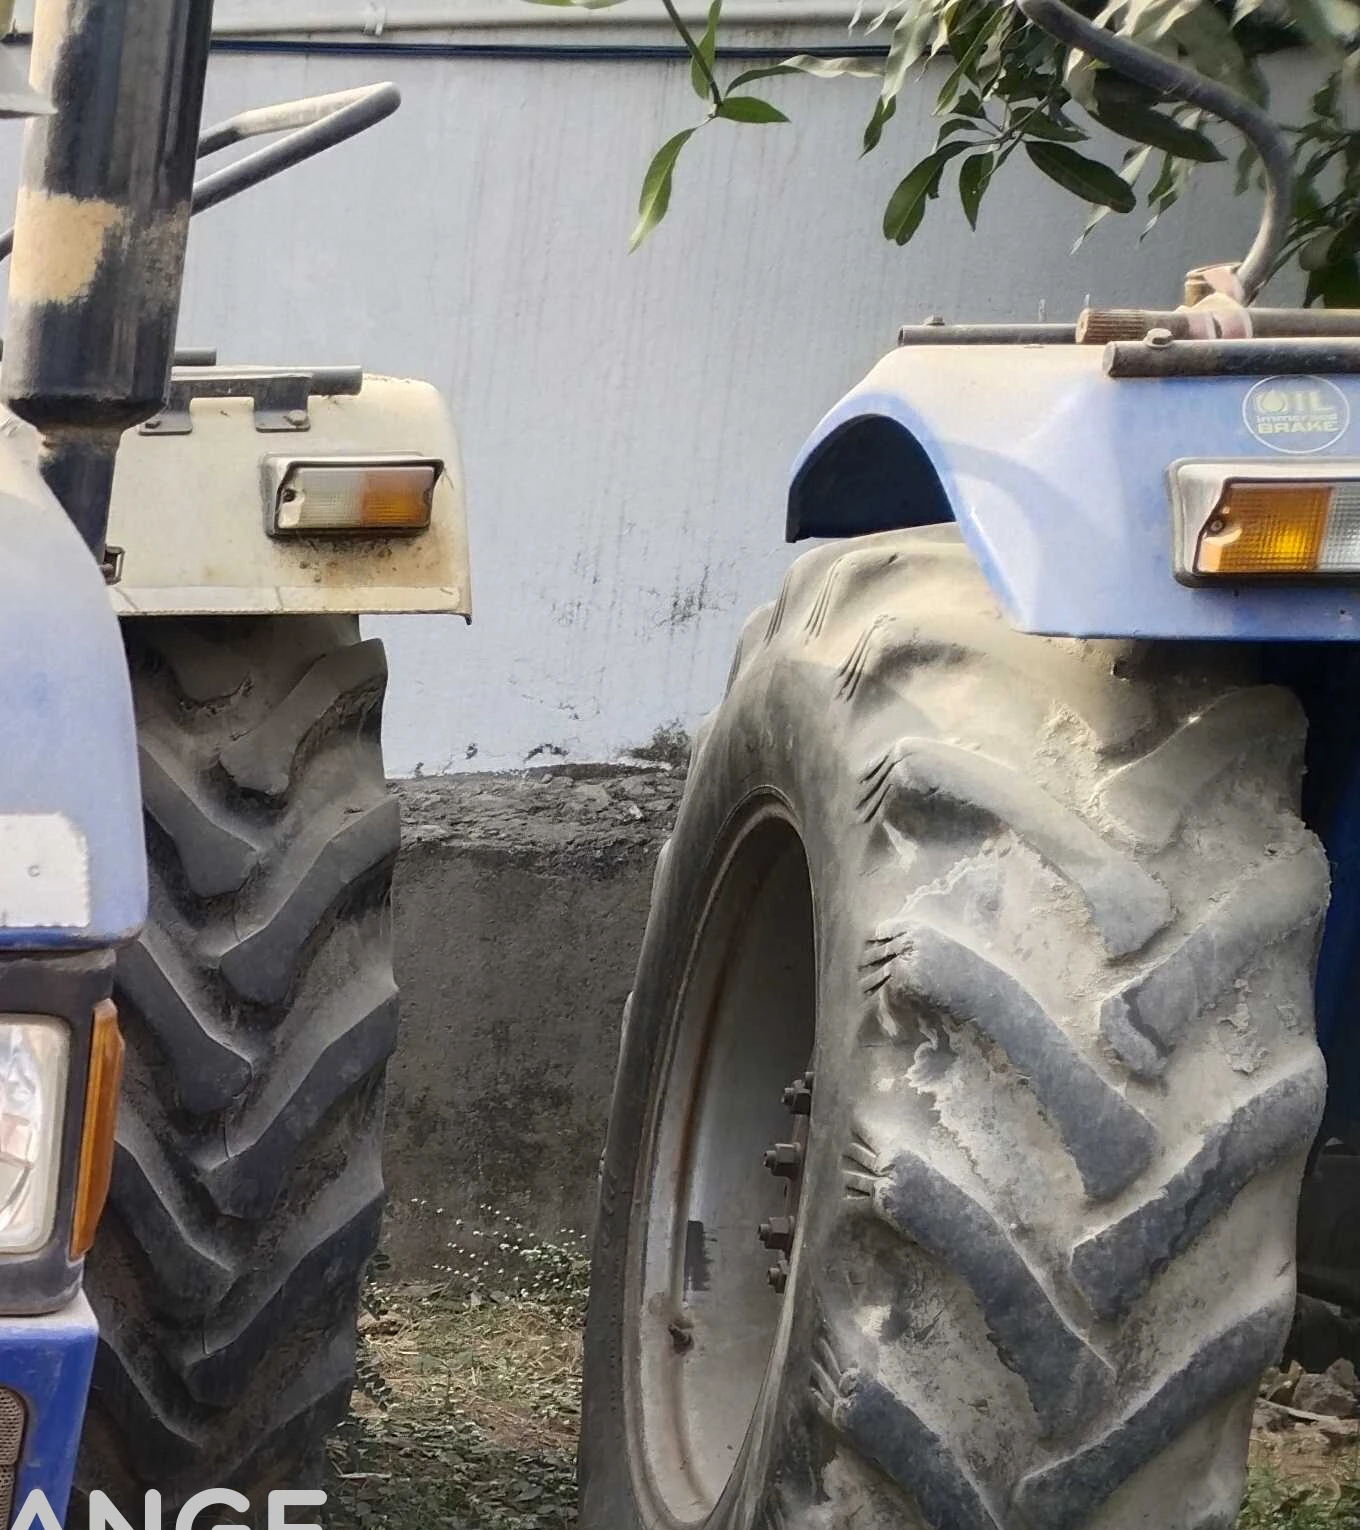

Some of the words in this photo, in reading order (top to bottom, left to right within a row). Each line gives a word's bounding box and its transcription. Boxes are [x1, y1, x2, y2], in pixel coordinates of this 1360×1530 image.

[1255, 390, 1335, 414] OIL
[1258, 421, 1340, 434] BRAKE
[27, 864, 41, 878] C
